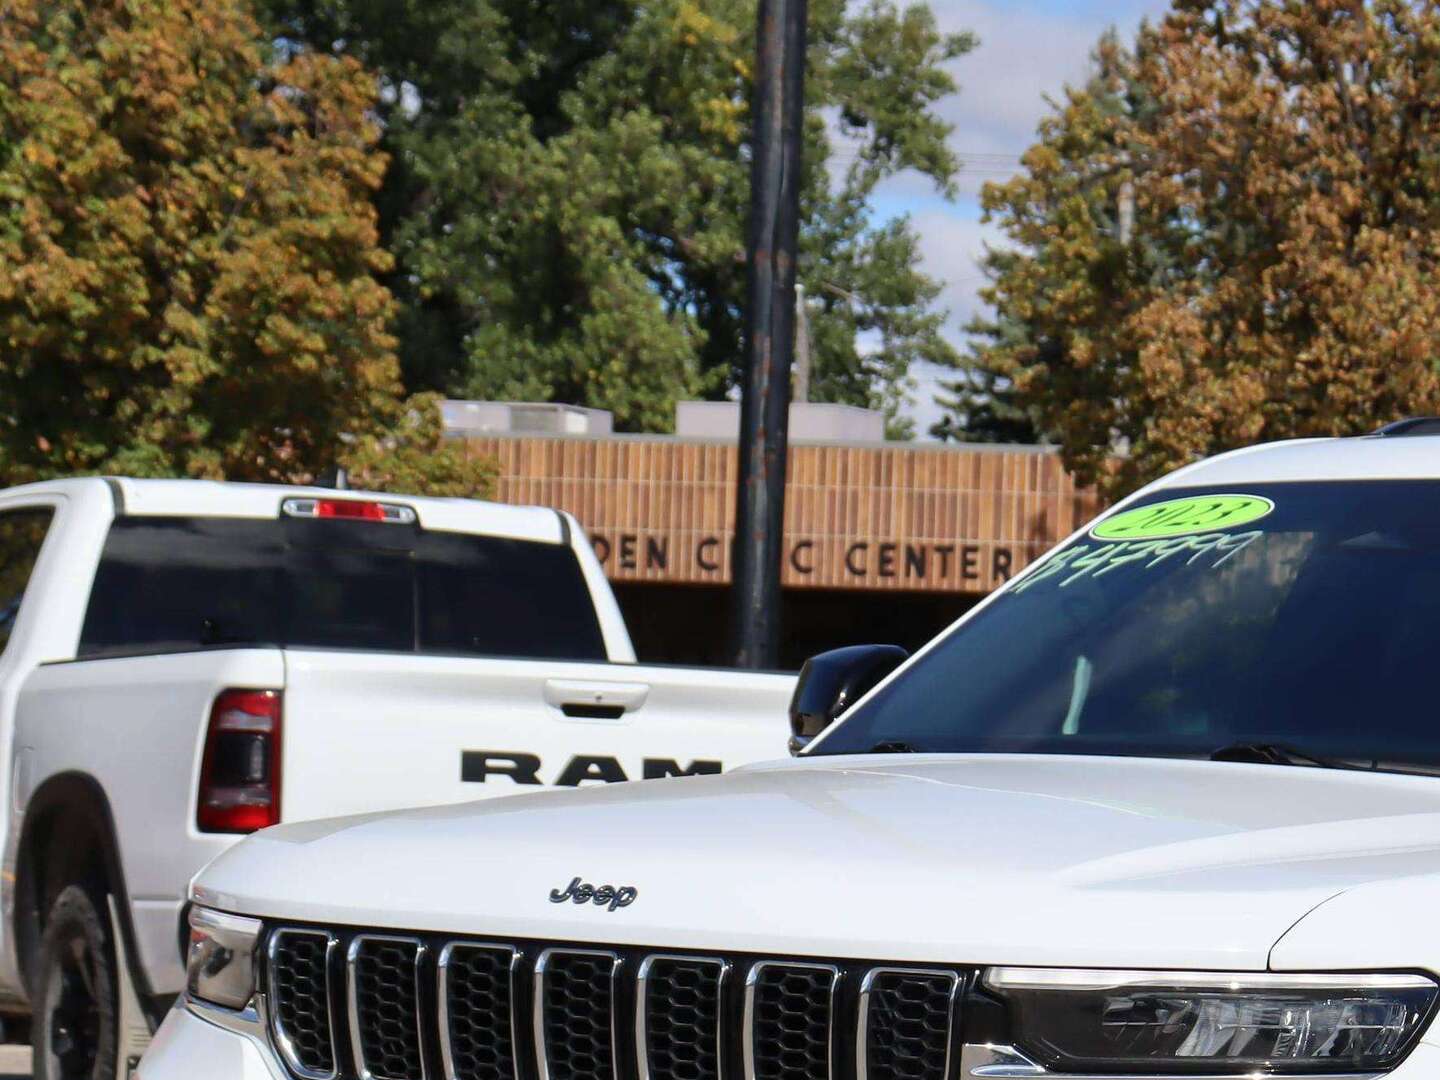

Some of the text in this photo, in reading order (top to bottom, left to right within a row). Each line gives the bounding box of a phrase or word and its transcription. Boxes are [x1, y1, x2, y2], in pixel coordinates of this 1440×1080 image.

[1109, 500, 1253, 534] 2023
[845, 542, 1012, 582] CENTER
[460, 750, 722, 787] RAM
[549, 876, 638, 912] Jeep
